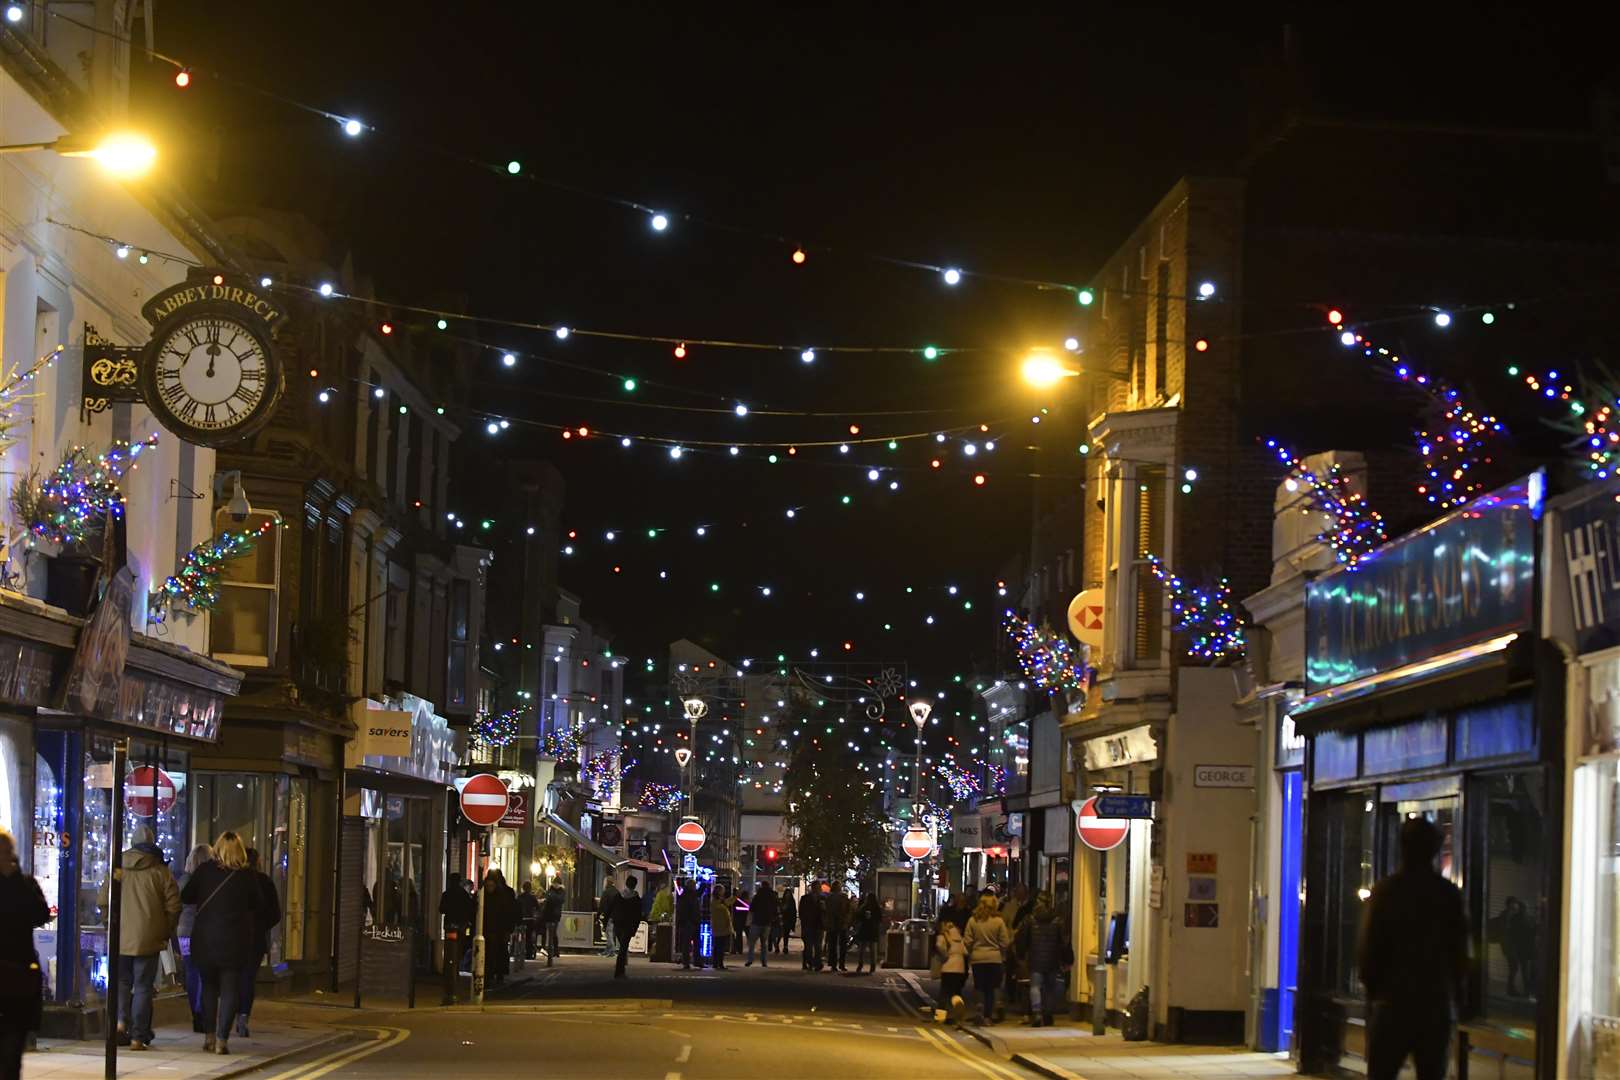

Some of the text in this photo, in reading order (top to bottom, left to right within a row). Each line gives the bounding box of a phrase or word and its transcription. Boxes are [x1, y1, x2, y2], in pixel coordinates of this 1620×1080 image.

[154, 285, 279, 321] ABBEY DIRECT
[369, 727, 409, 738] savers
[1198, 771, 1247, 783] GEORGE
[959, 826, 978, 835] M&S
